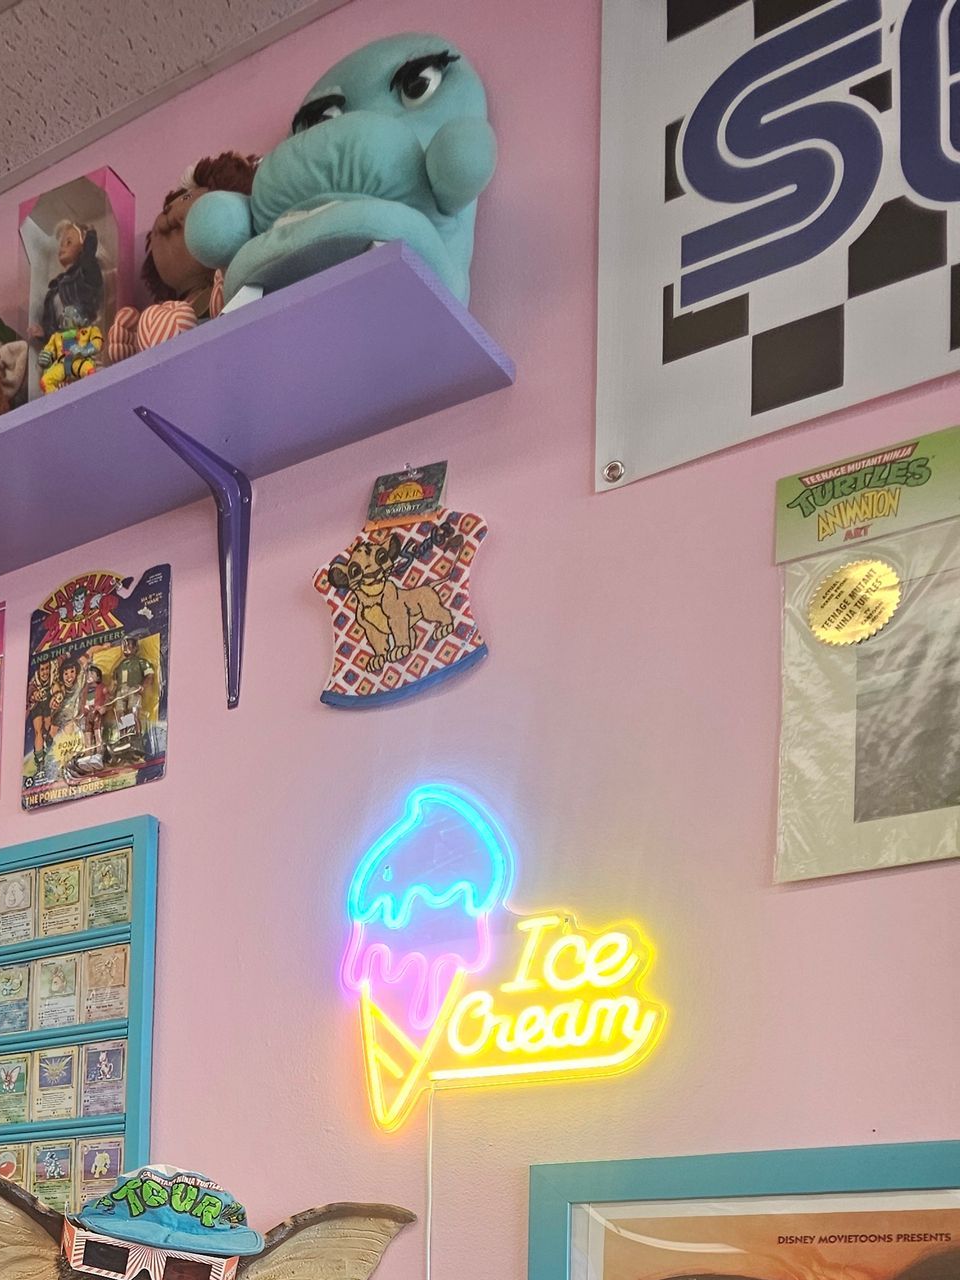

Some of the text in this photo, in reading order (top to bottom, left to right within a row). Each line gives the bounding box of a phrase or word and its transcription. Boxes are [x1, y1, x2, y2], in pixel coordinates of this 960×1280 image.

[803, 446, 913, 485] TEENAGE MUTANT NINJA
[786, 457, 932, 518] TURTLES
[817, 487, 902, 542] ANIMATION
[843, 524, 872, 542] ART
[31, 630, 125, 665] AND THE PLANETEERS
[32, 612, 124, 655] PLANET
[26, 781, 104, 805] THE POWER IS YOURS
[500, 915, 641, 992] Ice
[445, 989, 659, 1057] Cream
[176, 1175, 195, 1185] NINJA
[111, 1178, 222, 1227] TOUR
[777, 1232, 951, 1244] DISNEY MOVIETOONS PRESENTS
